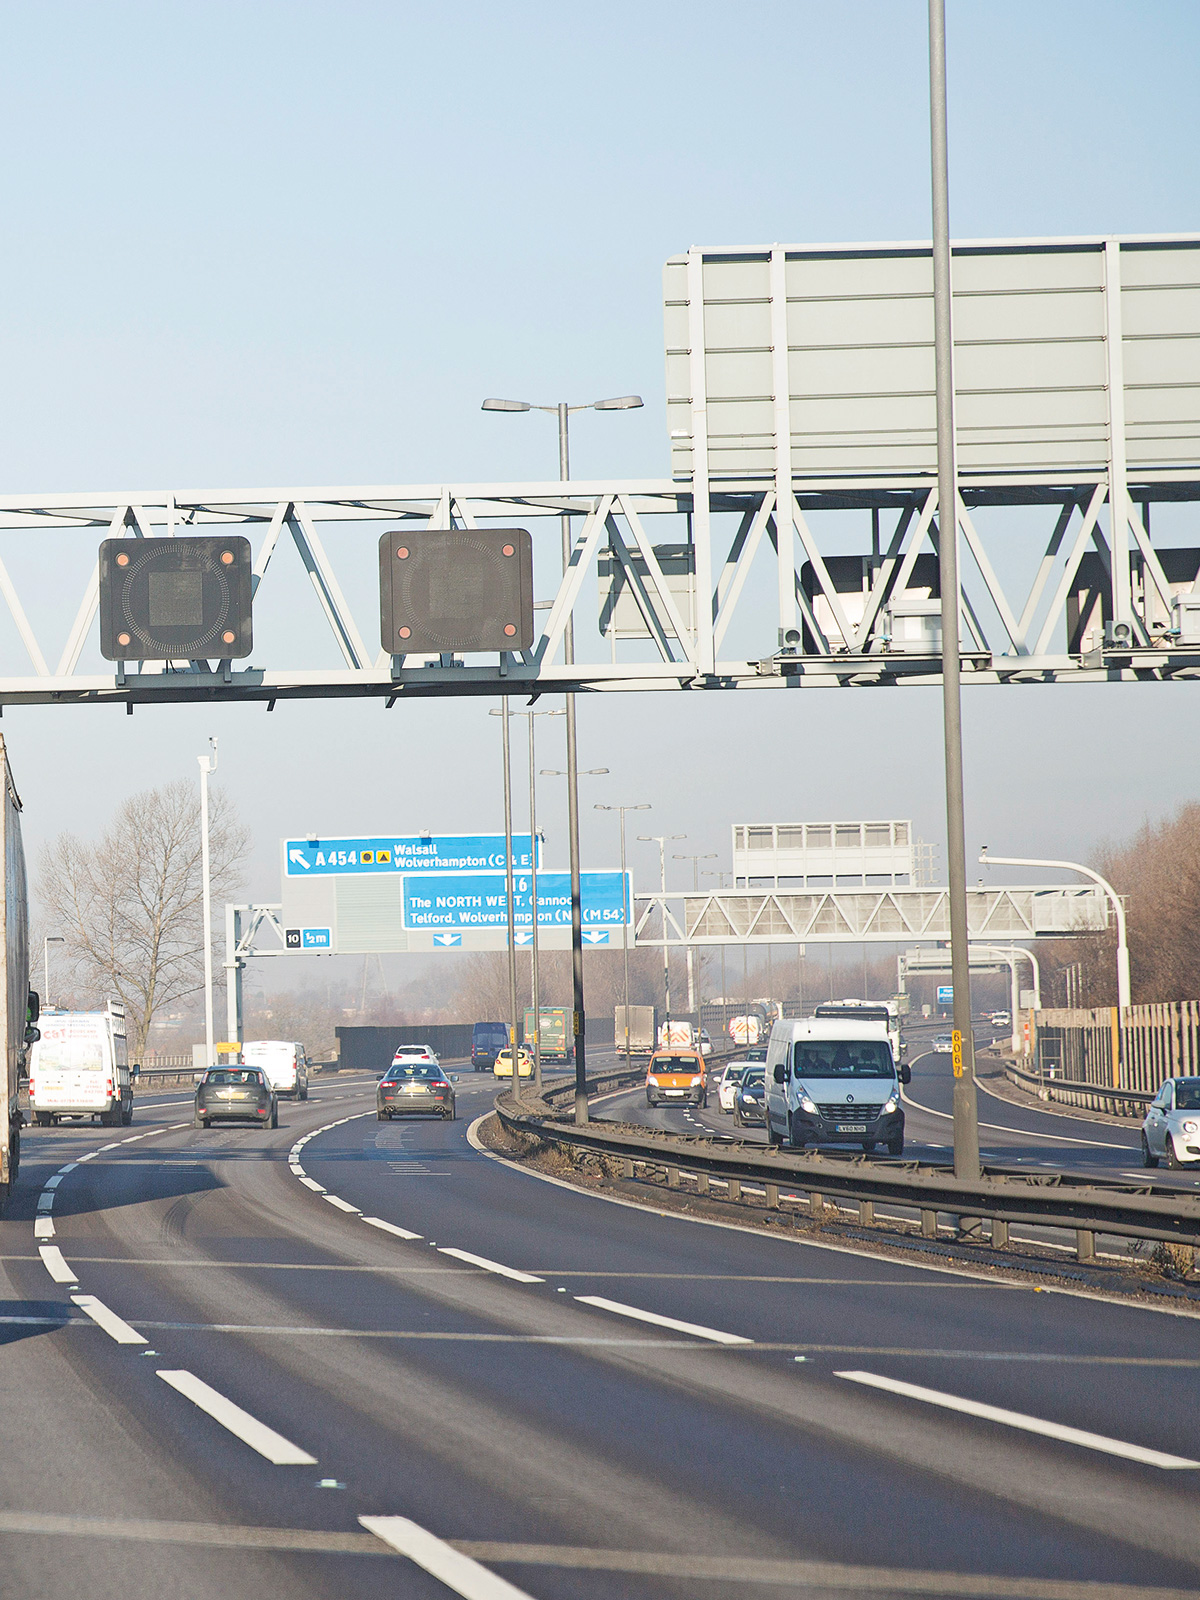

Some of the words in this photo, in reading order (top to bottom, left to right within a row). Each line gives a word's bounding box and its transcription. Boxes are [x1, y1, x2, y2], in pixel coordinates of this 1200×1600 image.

[393, 844, 438, 856] Walsall
[315, 851, 357, 867] A454
[394, 856, 486, 868] Wolverhampton
[409, 897, 432, 908] The
[436, 896, 482, 908] NORTH
[485, 895, 525, 907] WET,
[528, 895, 573, 906] Cannoc
[410, 912, 456, 924] Telford,
[459, 910, 552, 924] Wolverhmpon
[287, 934, 300, 944] 10
[953, 1031, 961, 1076] 6067
